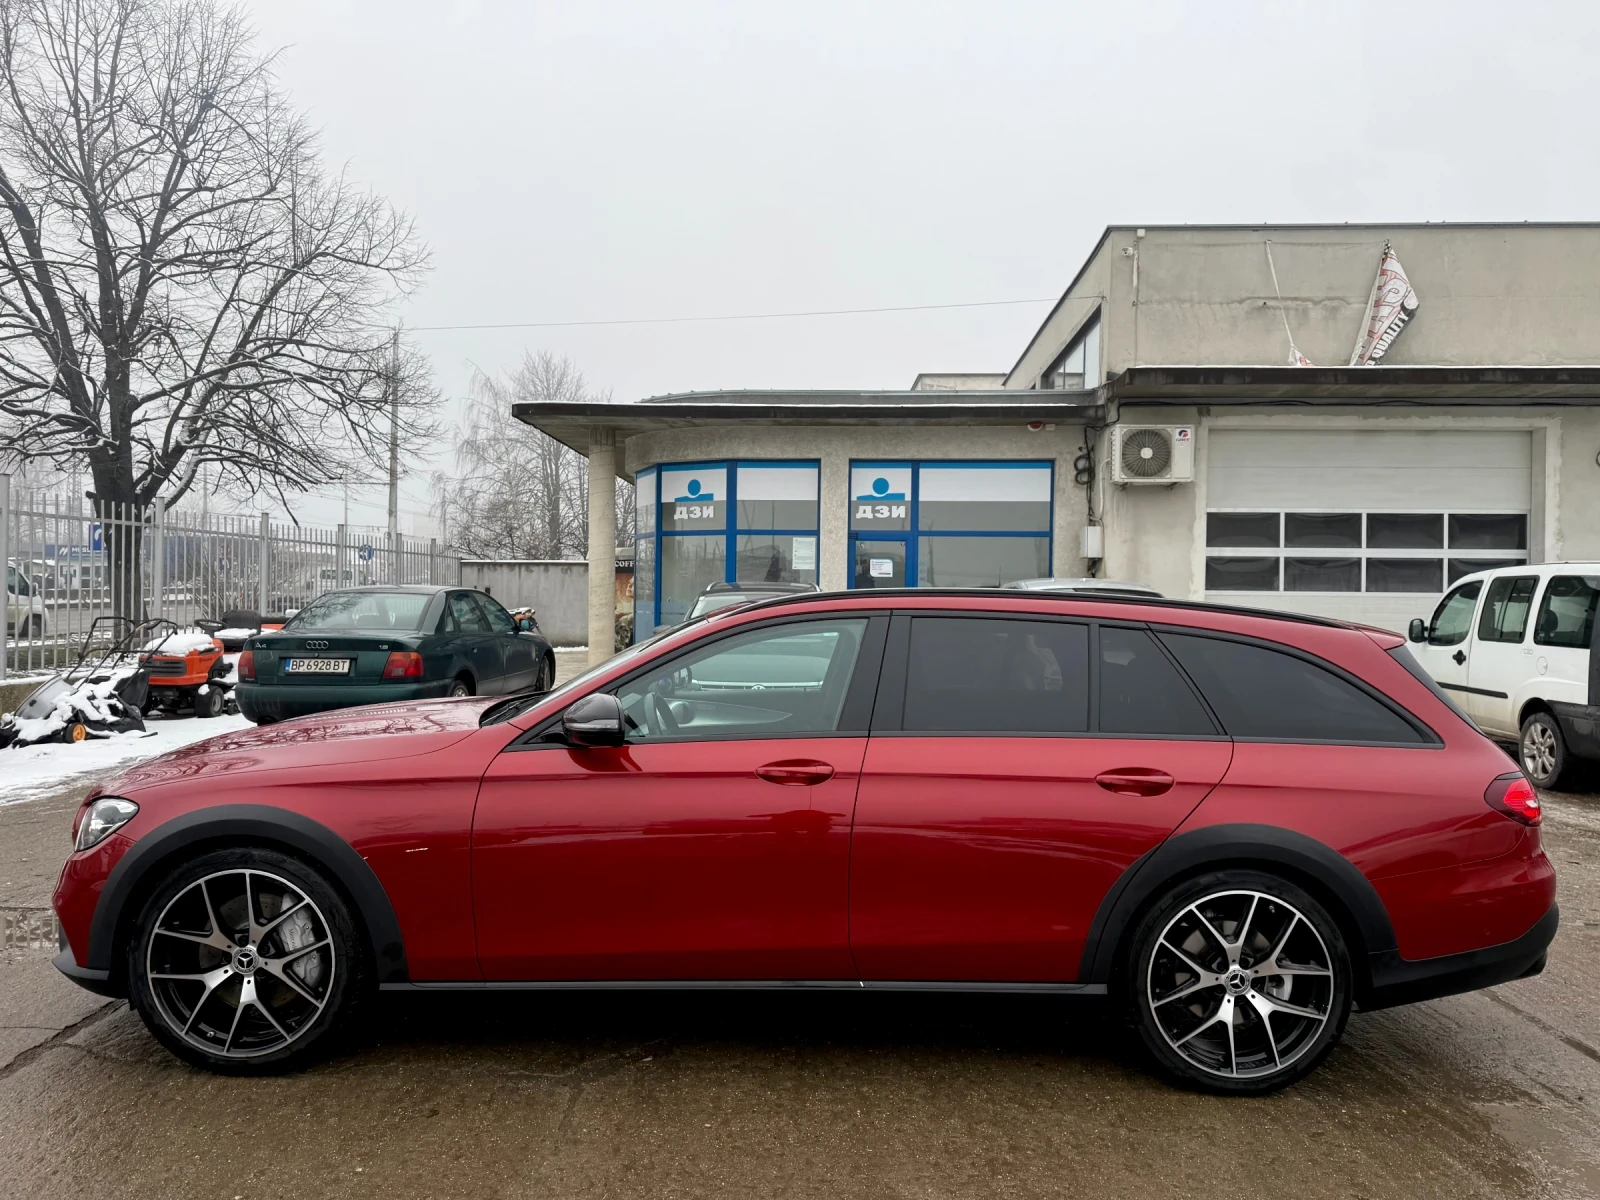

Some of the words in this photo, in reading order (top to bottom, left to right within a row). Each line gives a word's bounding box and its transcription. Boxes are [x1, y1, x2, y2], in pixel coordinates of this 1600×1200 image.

[1371, 310, 1409, 358] QUALITY
[673, 505, 714, 520] ДЗИ
[855, 505, 906, 519] ДЗИ
[614, 560, 635, 568] COFF
[306, 660, 332, 671] 6928
